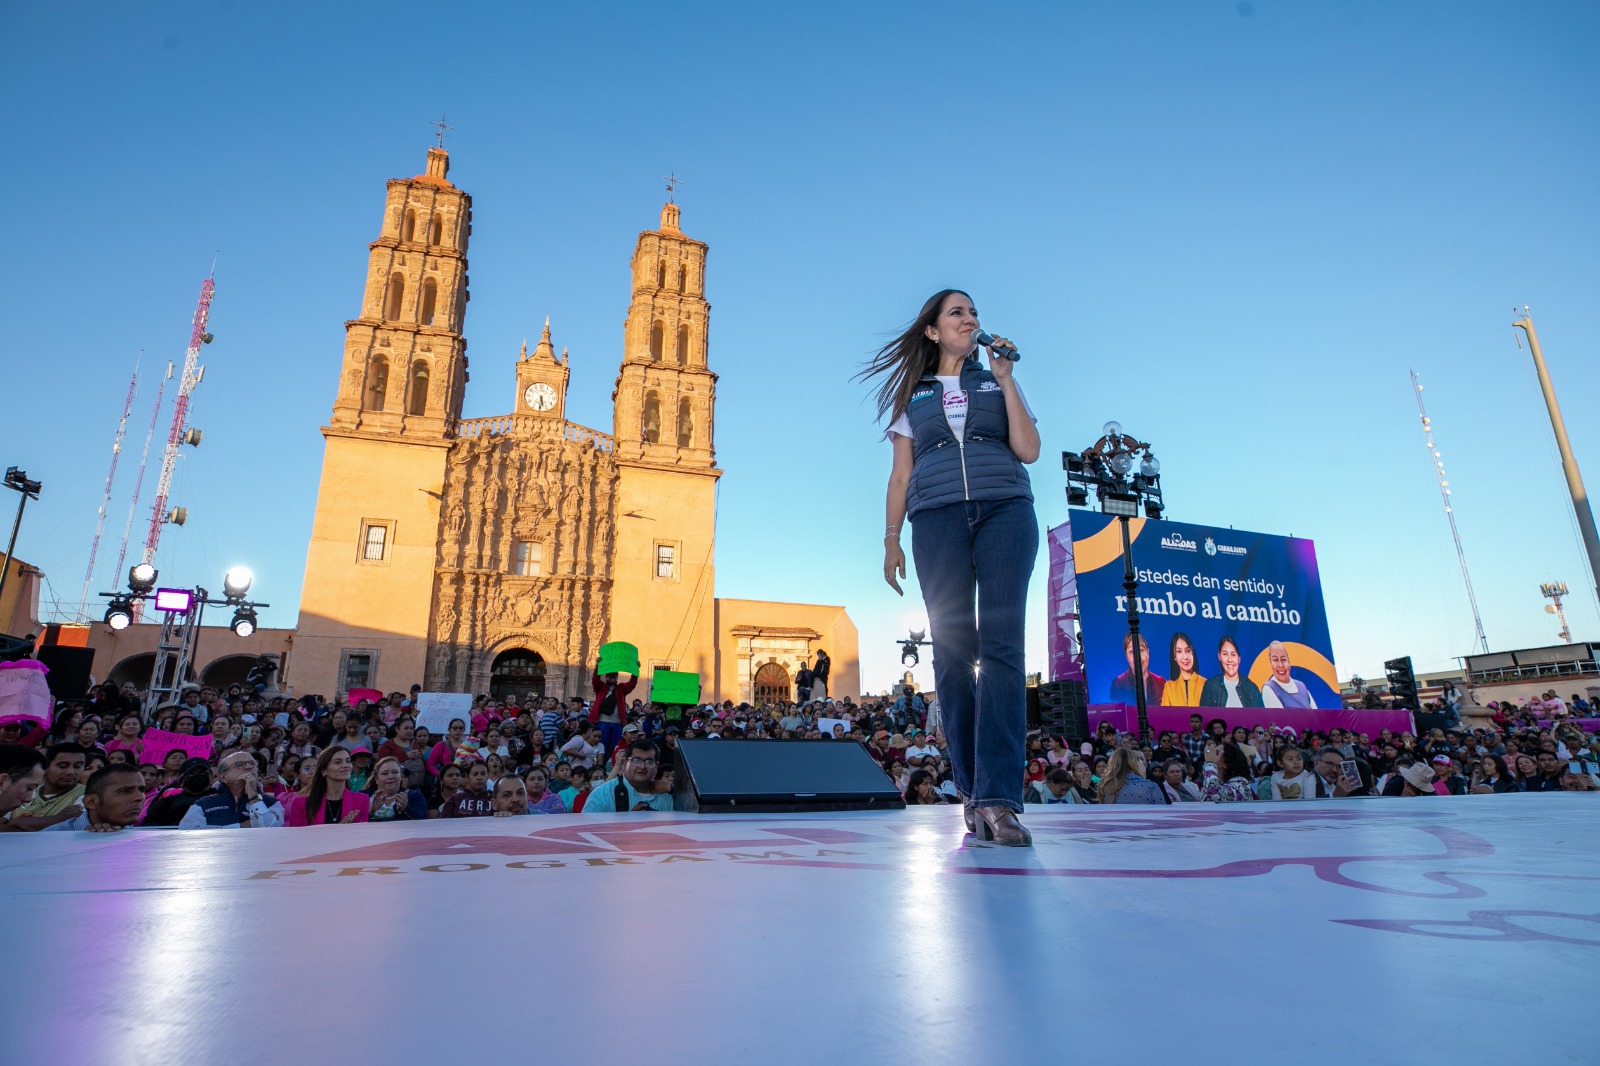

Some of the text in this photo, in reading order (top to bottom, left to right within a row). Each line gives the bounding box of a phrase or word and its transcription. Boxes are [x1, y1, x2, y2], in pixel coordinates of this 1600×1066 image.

[1193, 572, 1220, 590] dan
[1224, 577, 1274, 594] sentido
[1276, 584, 1285, 598] y
[1202, 596, 1222, 620] al
[1226, 600, 1301, 625] cambio
[245, 849, 866, 880] PROGRAMA
